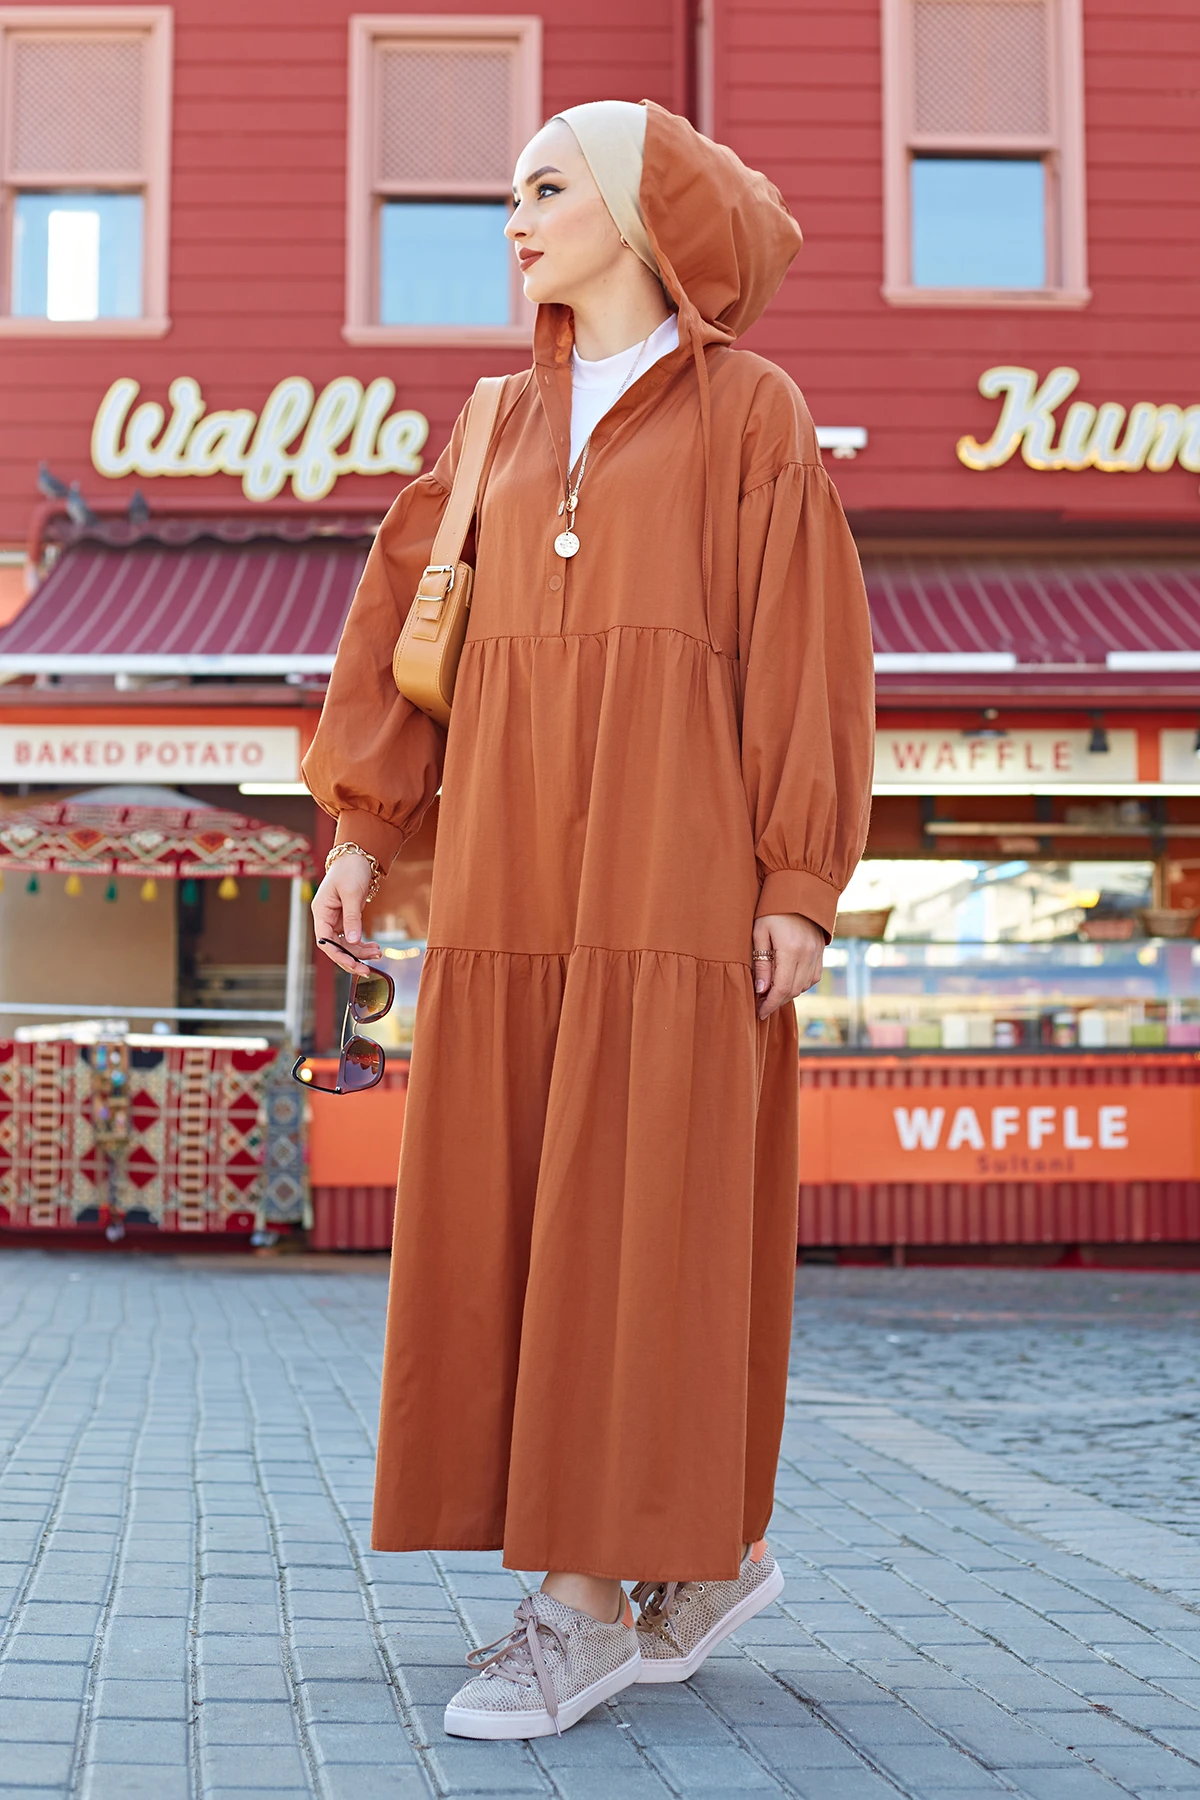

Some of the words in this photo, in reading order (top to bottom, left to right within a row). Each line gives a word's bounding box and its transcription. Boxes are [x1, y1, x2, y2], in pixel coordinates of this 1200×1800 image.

[91, 376, 429, 501] Waffle
[14, 741, 124, 766] BAKED
[135, 741, 264, 767] POTATO
[893, 740, 1072, 770] WAFFLE
[894, 1106, 1129, 1150] WAFFLE
